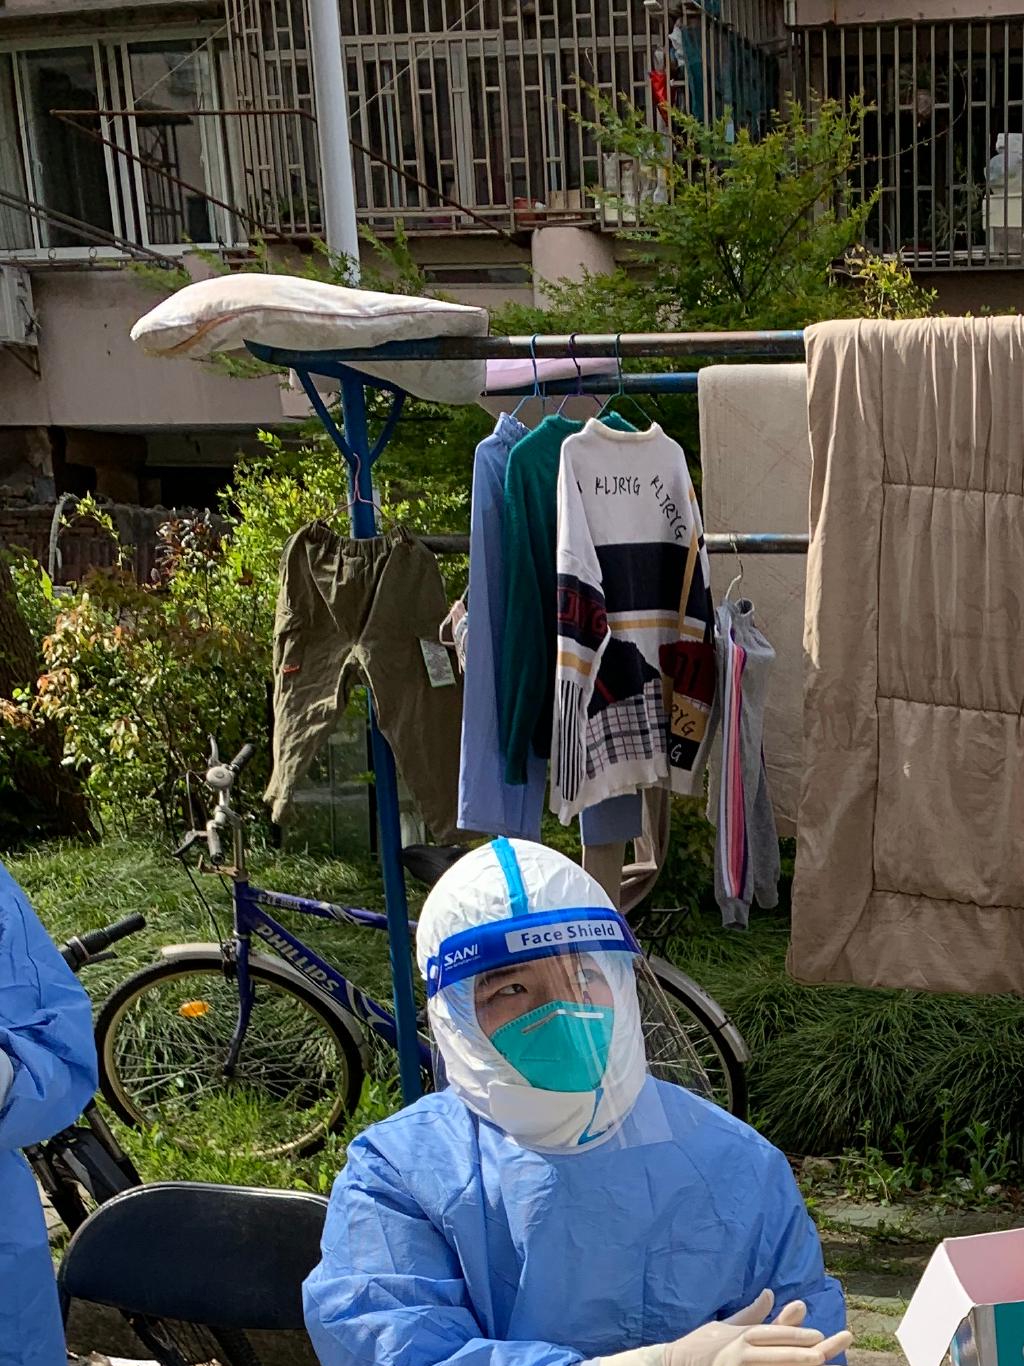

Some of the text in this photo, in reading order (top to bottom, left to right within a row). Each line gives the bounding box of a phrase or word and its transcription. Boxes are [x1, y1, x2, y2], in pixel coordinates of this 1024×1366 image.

[521, 924, 615, 946] Face Shield
[256, 923, 340, 992] PHILLIPS
[444, 944, 478, 967] SANI
